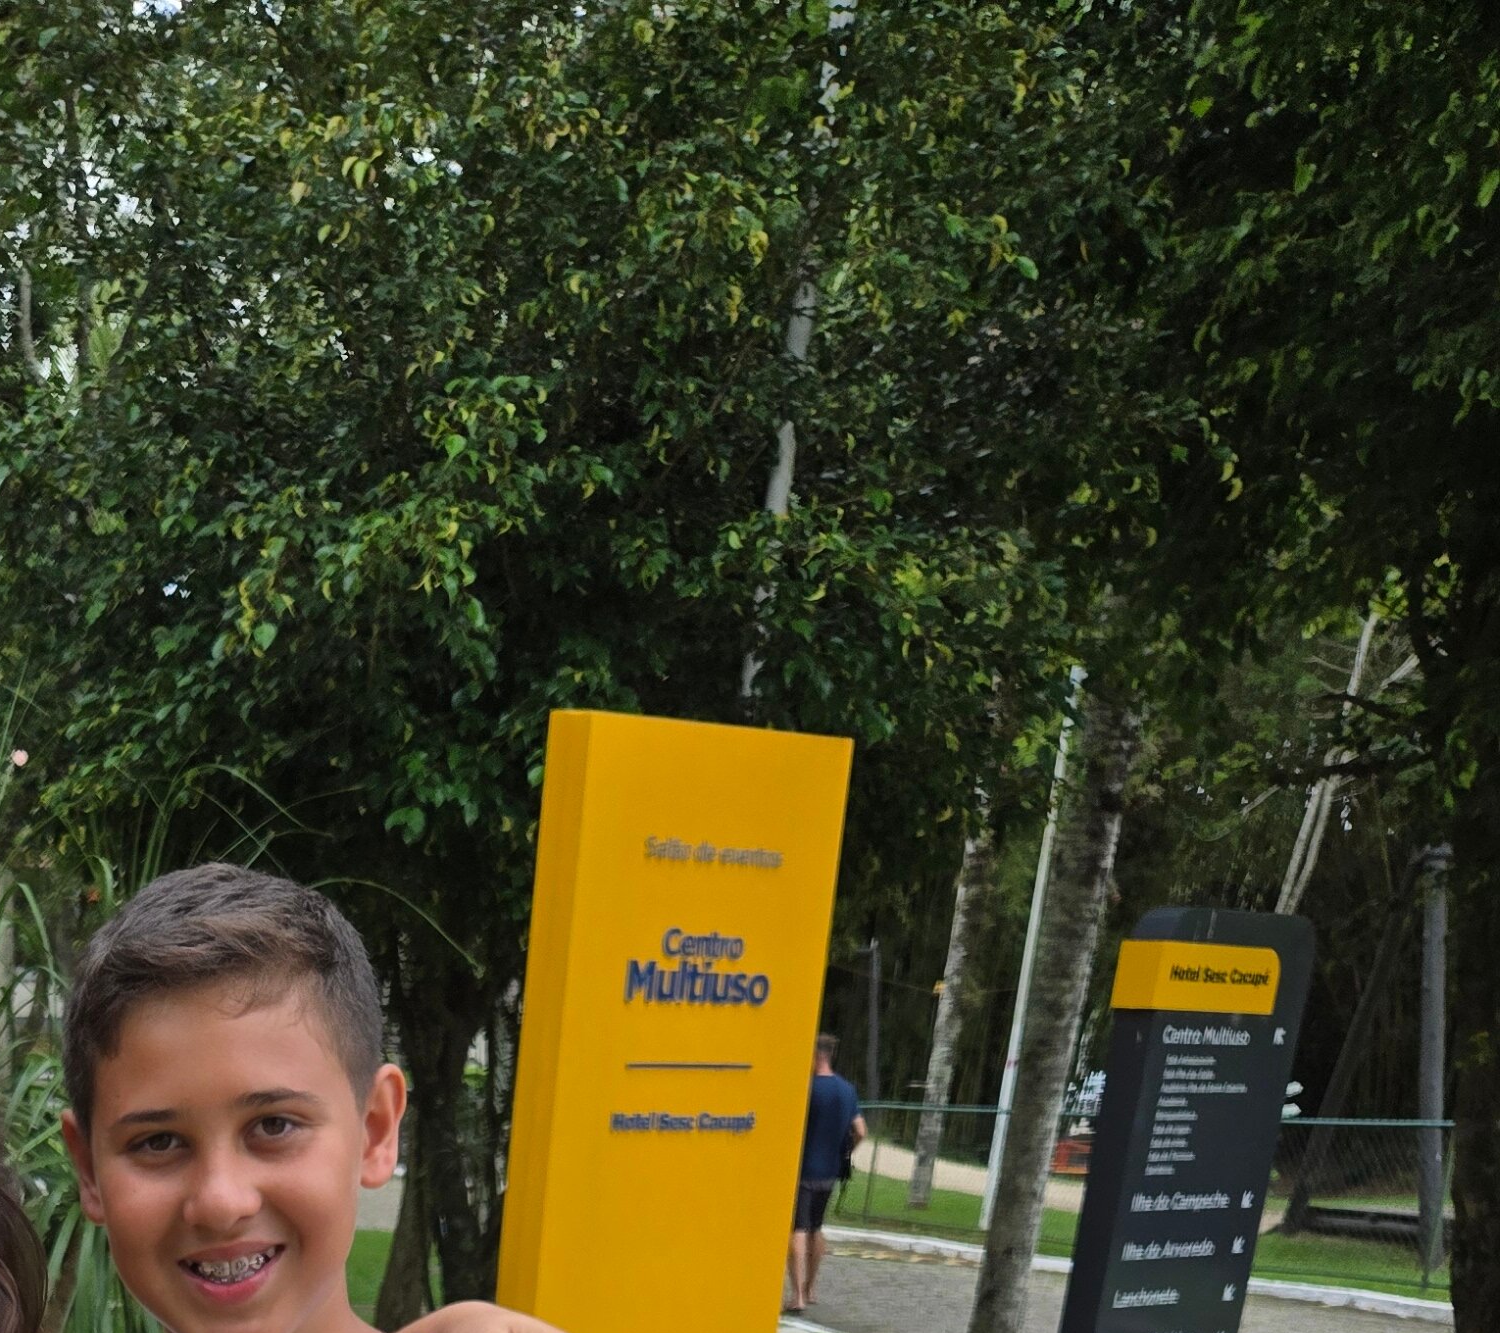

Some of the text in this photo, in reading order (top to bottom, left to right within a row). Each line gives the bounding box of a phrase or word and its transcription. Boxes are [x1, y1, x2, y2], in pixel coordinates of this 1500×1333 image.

[663, 927, 744, 960] Centro
[625, 960, 770, 1006] Multiuso
[1170, 964, 1201, 982] Hotel
[1162, 1024, 1250, 1046] Centro Multiuso
[611, 1112, 658, 1132] Hotel
[1131, 1192, 1153, 1212] Ilha
[1170, 1190, 1230, 1212] Campeche
[1122, 1241, 1145, 1261] Ilha
[1112, 1286, 1180, 1308] Lanchonete
